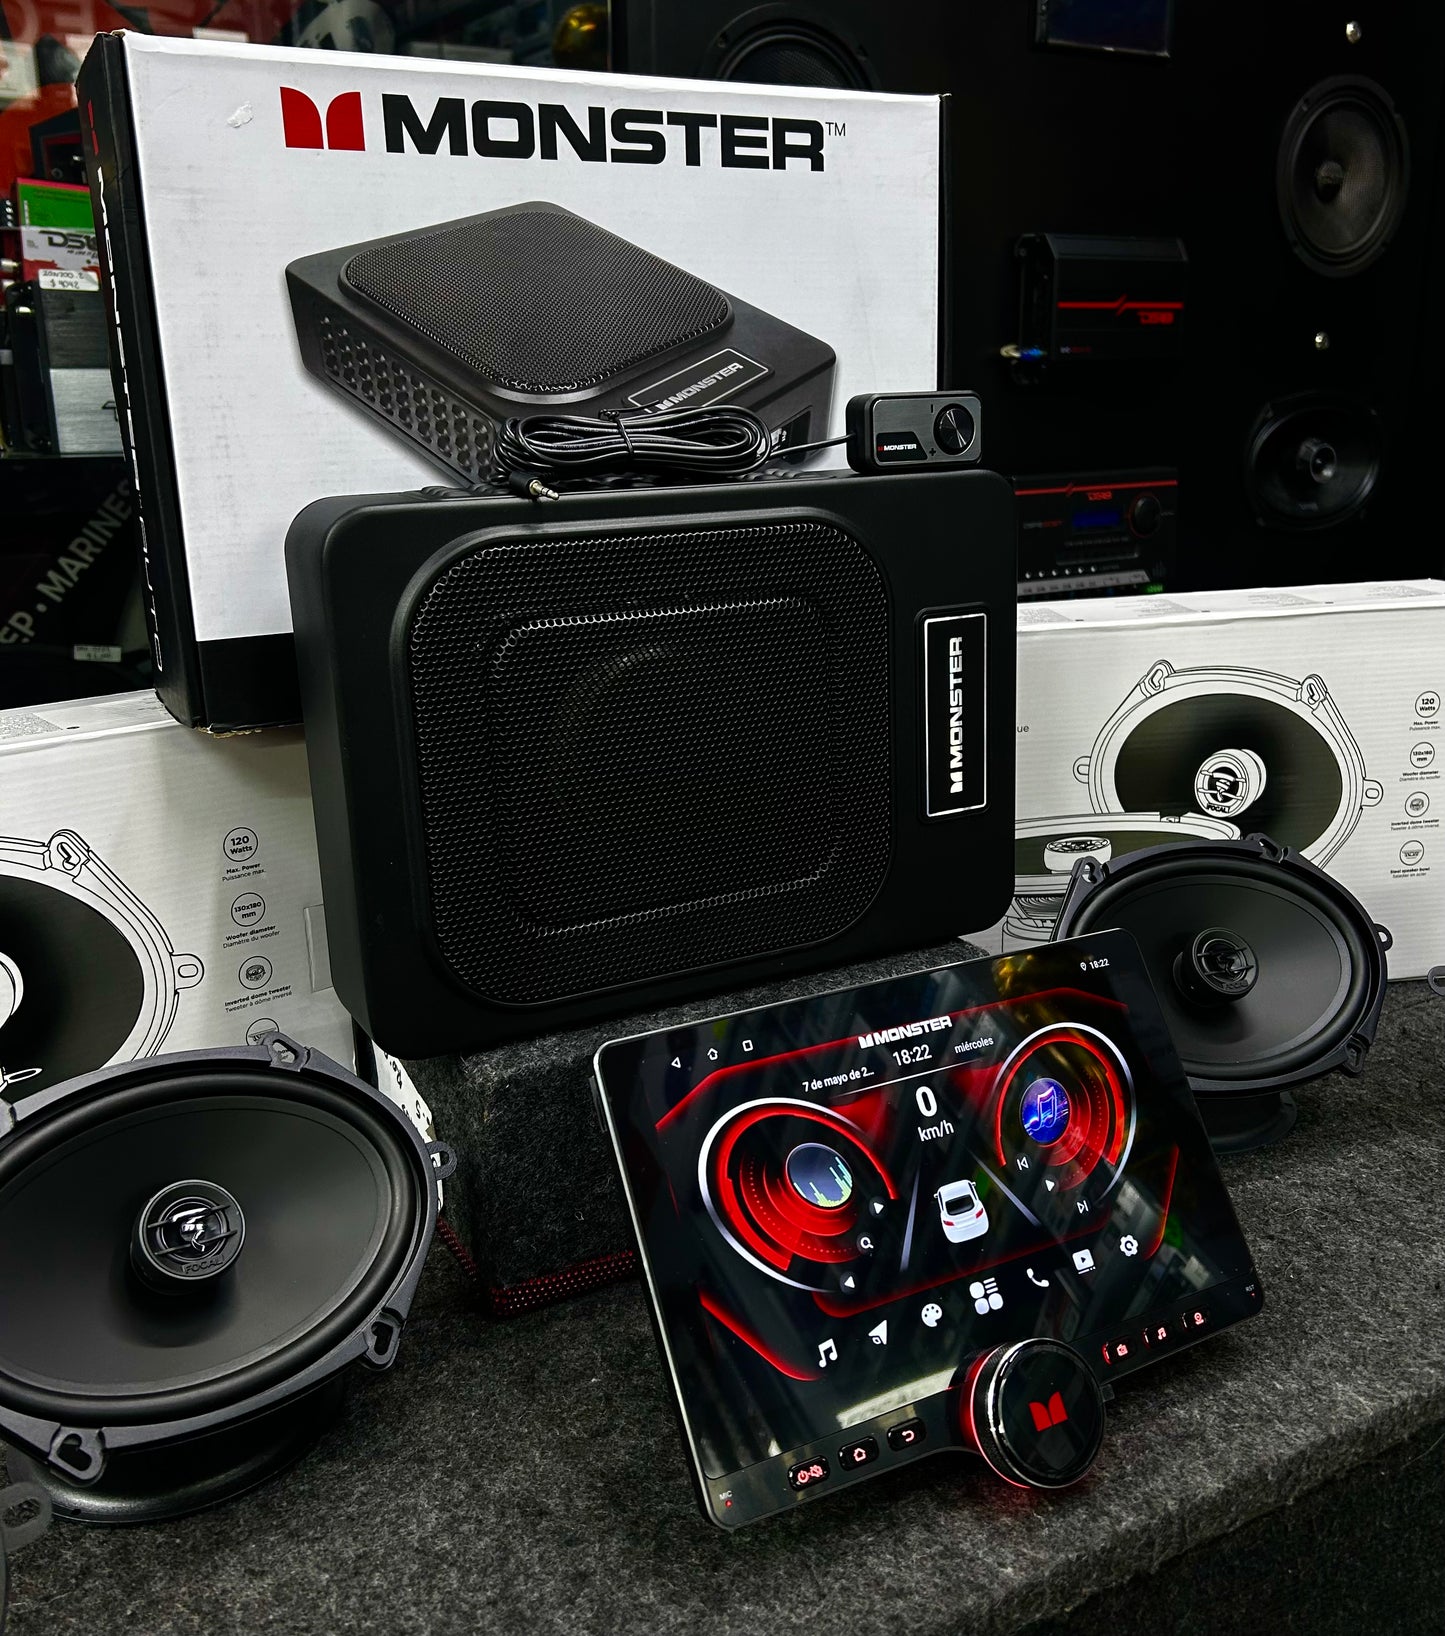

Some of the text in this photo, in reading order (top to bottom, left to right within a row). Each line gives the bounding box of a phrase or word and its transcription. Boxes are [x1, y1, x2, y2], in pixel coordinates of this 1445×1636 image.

[382, 93, 824, 172] MONSTER
[668, 362, 744, 405] MONSTER
[883, 443, 917, 451] MONSTER
[950, 637, 963, 769] MONSTER
[231, 835, 249, 846] 120
[230, 846, 253, 854] Watts
[222, 869, 266, 882] Puissance max.
[242, 863, 261, 871] Power
[234, 901, 262, 913] 130x180
[241, 911, 256, 919] mm
[223, 937, 250, 949] Diamètre
[260, 930, 280, 939] woofer
[226, 925, 276, 941] Woofer diameter
[1090, 958, 1110, 969] 18:22
[224, 985, 291, 1007] Inverted dome tweeter
[225, 1003, 248, 1013] Tweeter
[873, 1015, 953, 1046] MONSTER
[954, 1036, 994, 1054] miércoles
[892, 1044, 933, 1066] 18:22
[802, 1081, 809, 1093] 7
[811, 1077, 823, 1091] de
[825, 1073, 848, 1089] mayo
[849, 1068, 861, 1081] de
[915, 1086, 938, 1117] 0
[918, 1119, 955, 1142] km/h
[184, 1256, 224, 1274] FOCAL
[719, 1490, 733, 1500] MIC
